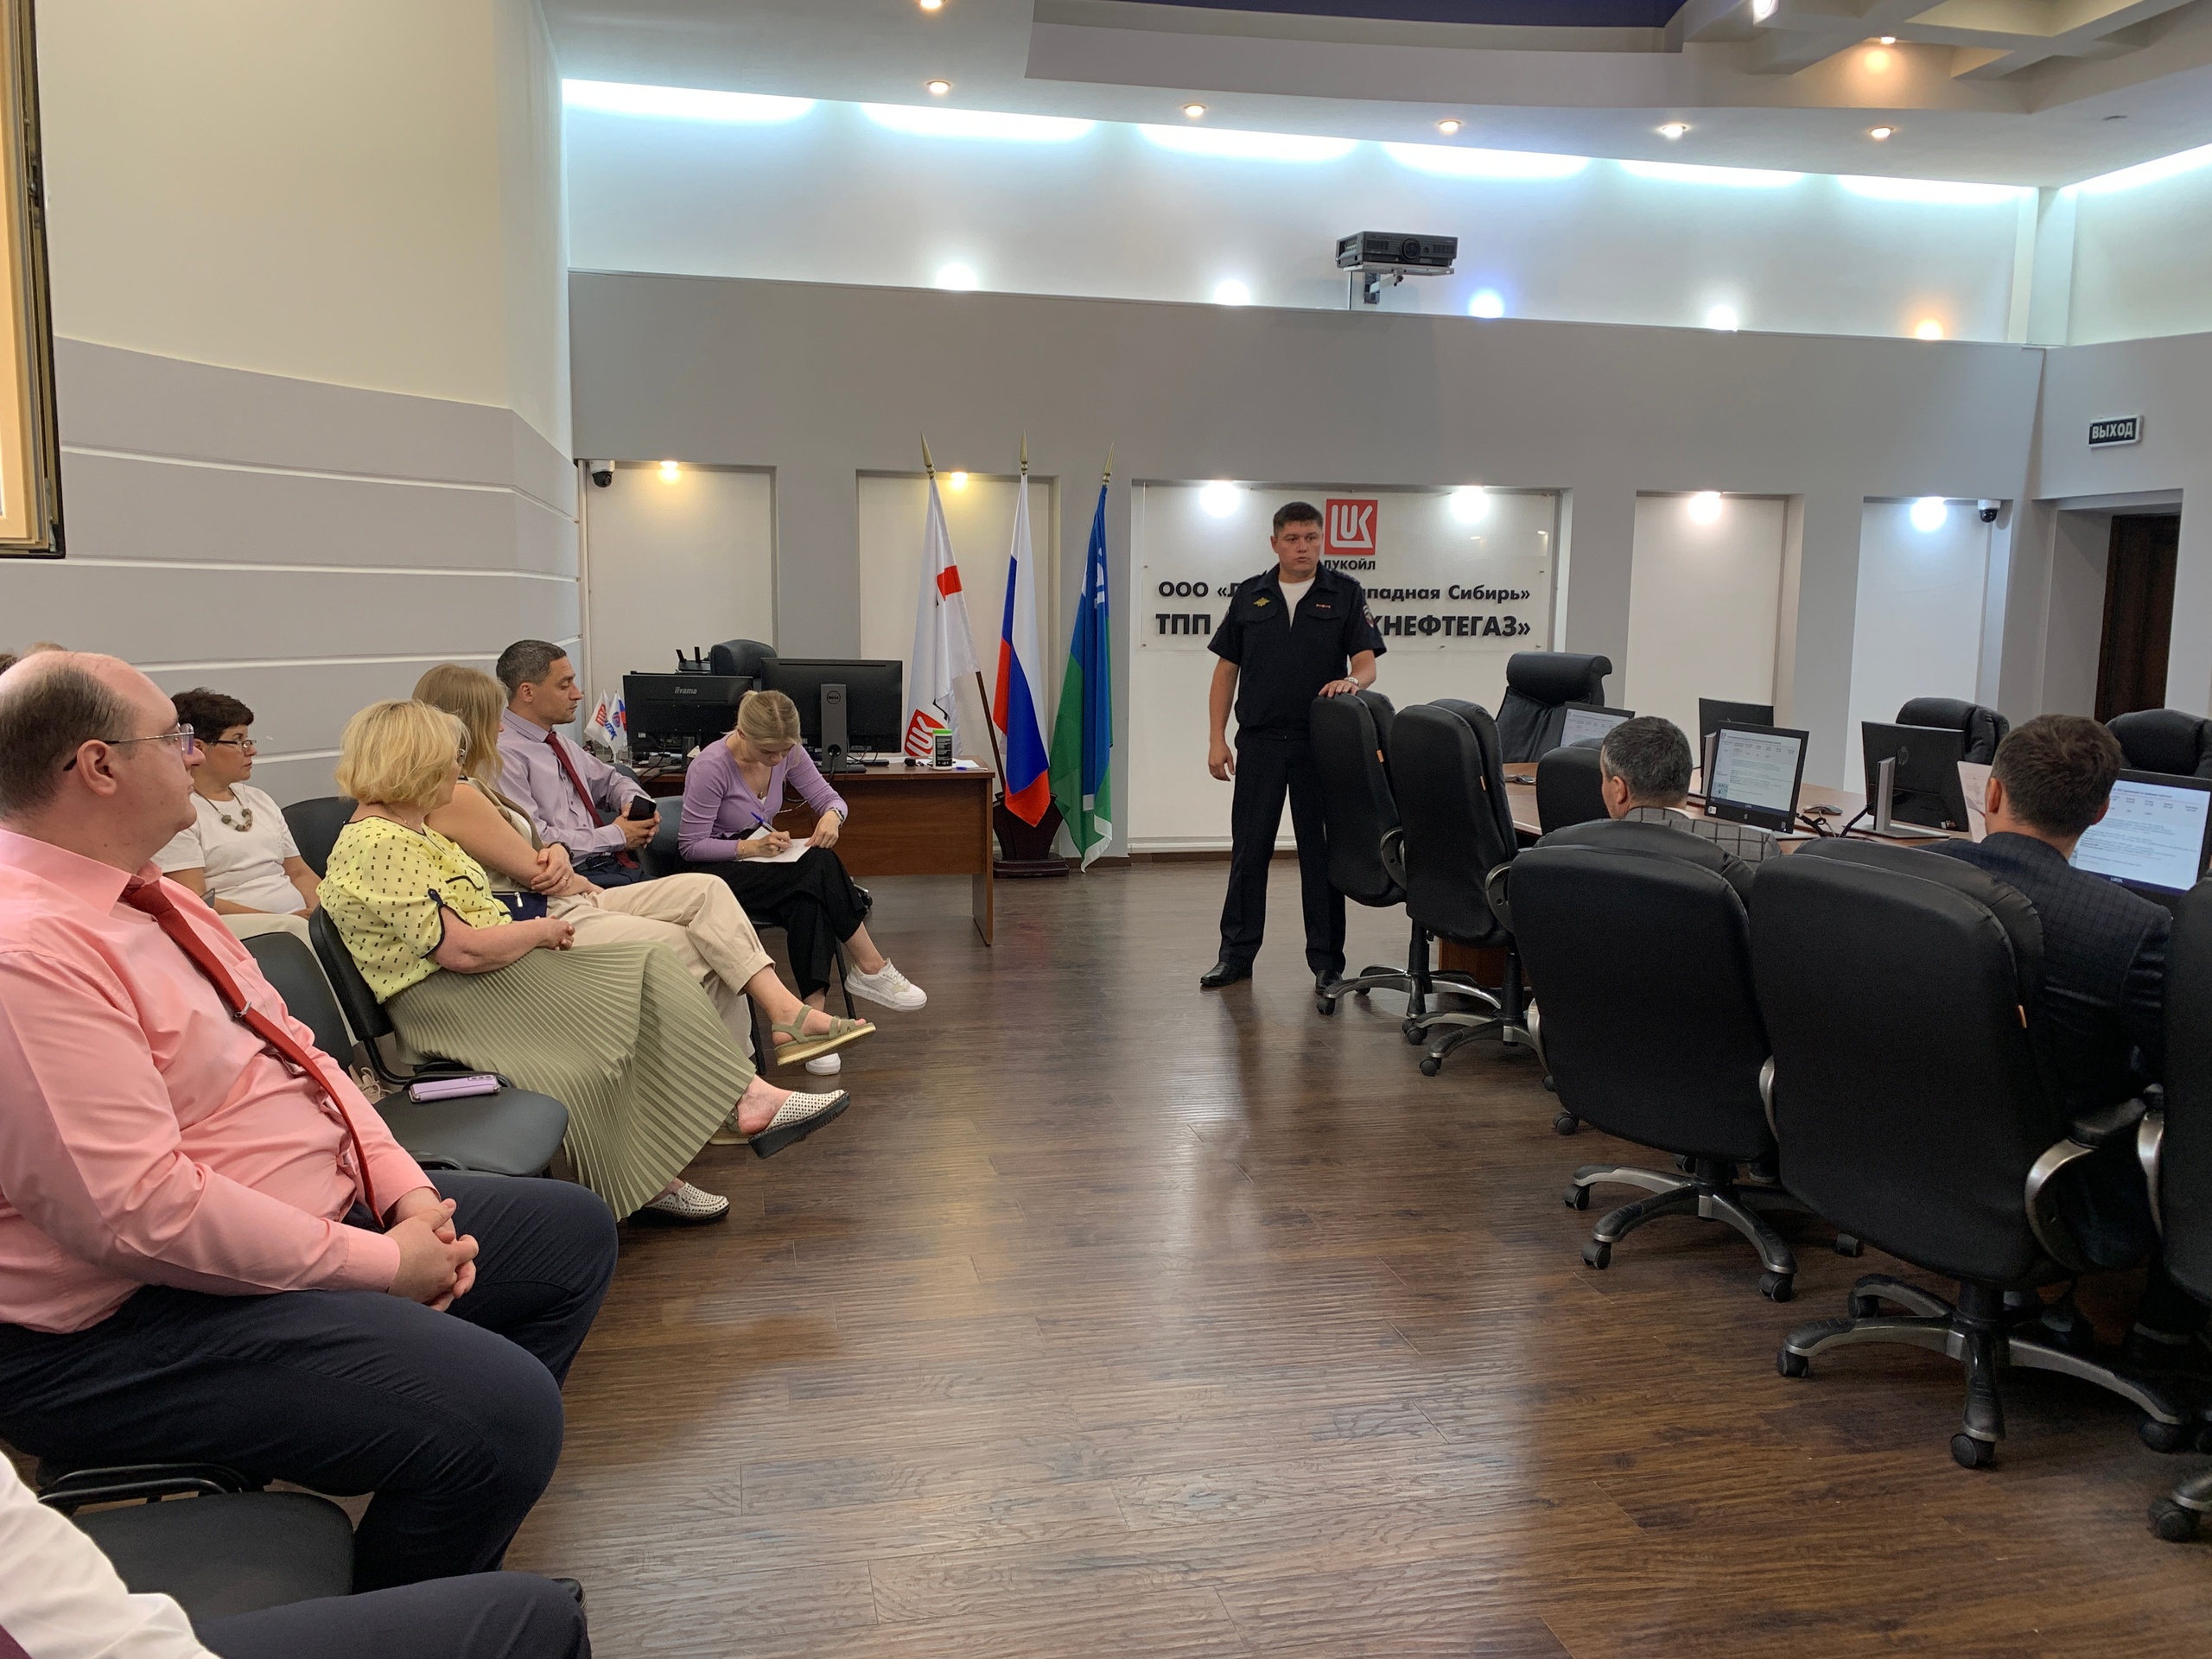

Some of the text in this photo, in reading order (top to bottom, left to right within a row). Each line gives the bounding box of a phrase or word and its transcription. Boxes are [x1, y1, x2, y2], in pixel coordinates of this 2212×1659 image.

[2092, 421, 2133, 439] ВЫХОД
[1324, 557, 1376, 570] ЛУКОЙЛ
[1158, 581, 1209, 598] ООО
[1363, 588, 1440, 602] падная
[1448, 584, 1530, 604] Сибирь»
[1155, 613, 1211, 635] ТПП
